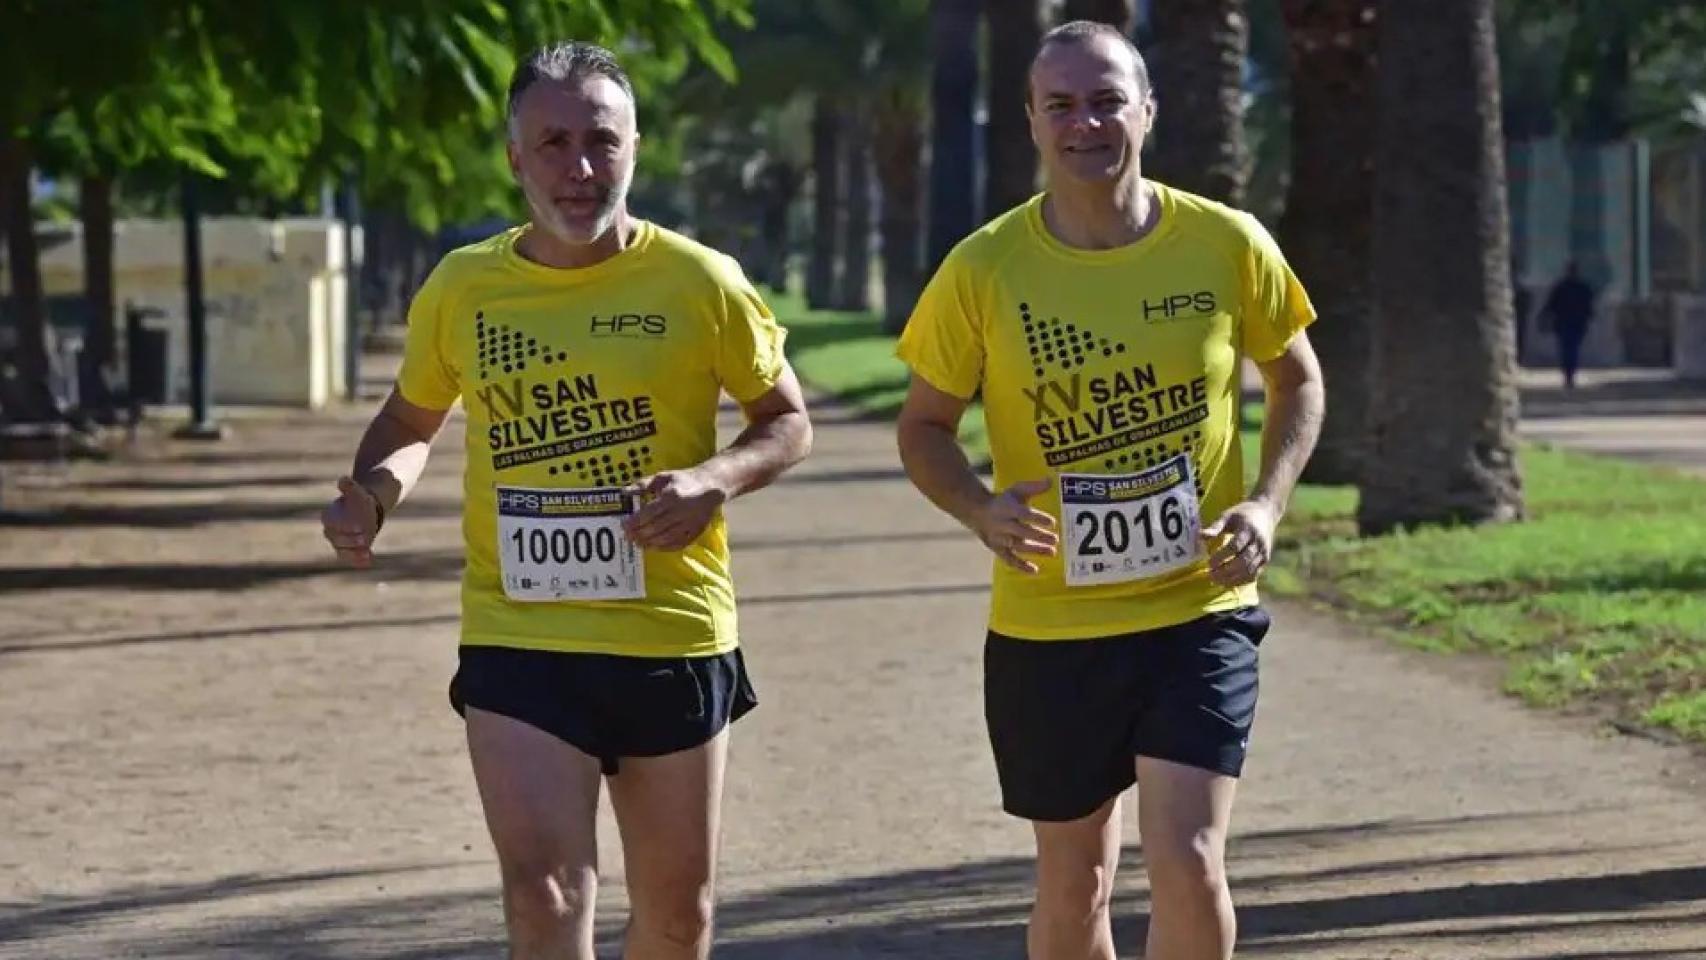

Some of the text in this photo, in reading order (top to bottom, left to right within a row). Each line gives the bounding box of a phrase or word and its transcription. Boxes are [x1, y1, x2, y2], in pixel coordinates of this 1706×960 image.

[590, 314, 666, 334] HPS
[1142, 291, 1216, 321] HPS
[476, 373, 598, 422] XV SAN
[1022, 362, 1156, 421] XV SAN
[1036, 376, 1207, 448] SILVESTRE
[489, 396, 653, 450] SILVESTRE
[495, 423, 654, 468] LAS PALMAS DE GRAN CANARIA
[1049, 407, 1208, 465] LAS PALMAS DE GRAN CANARIA
[500, 491, 539, 509] HPS
[541, 495, 562, 505] SAN
[564, 493, 620, 505] SILVESTRE
[1063, 479, 1105, 496] HPS
[1108, 480, 1130, 491] SAN
[1131, 465, 1179, 489] SILVESTRE
[512, 527, 616, 564] 10000
[1076, 496, 1183, 556] 2016
